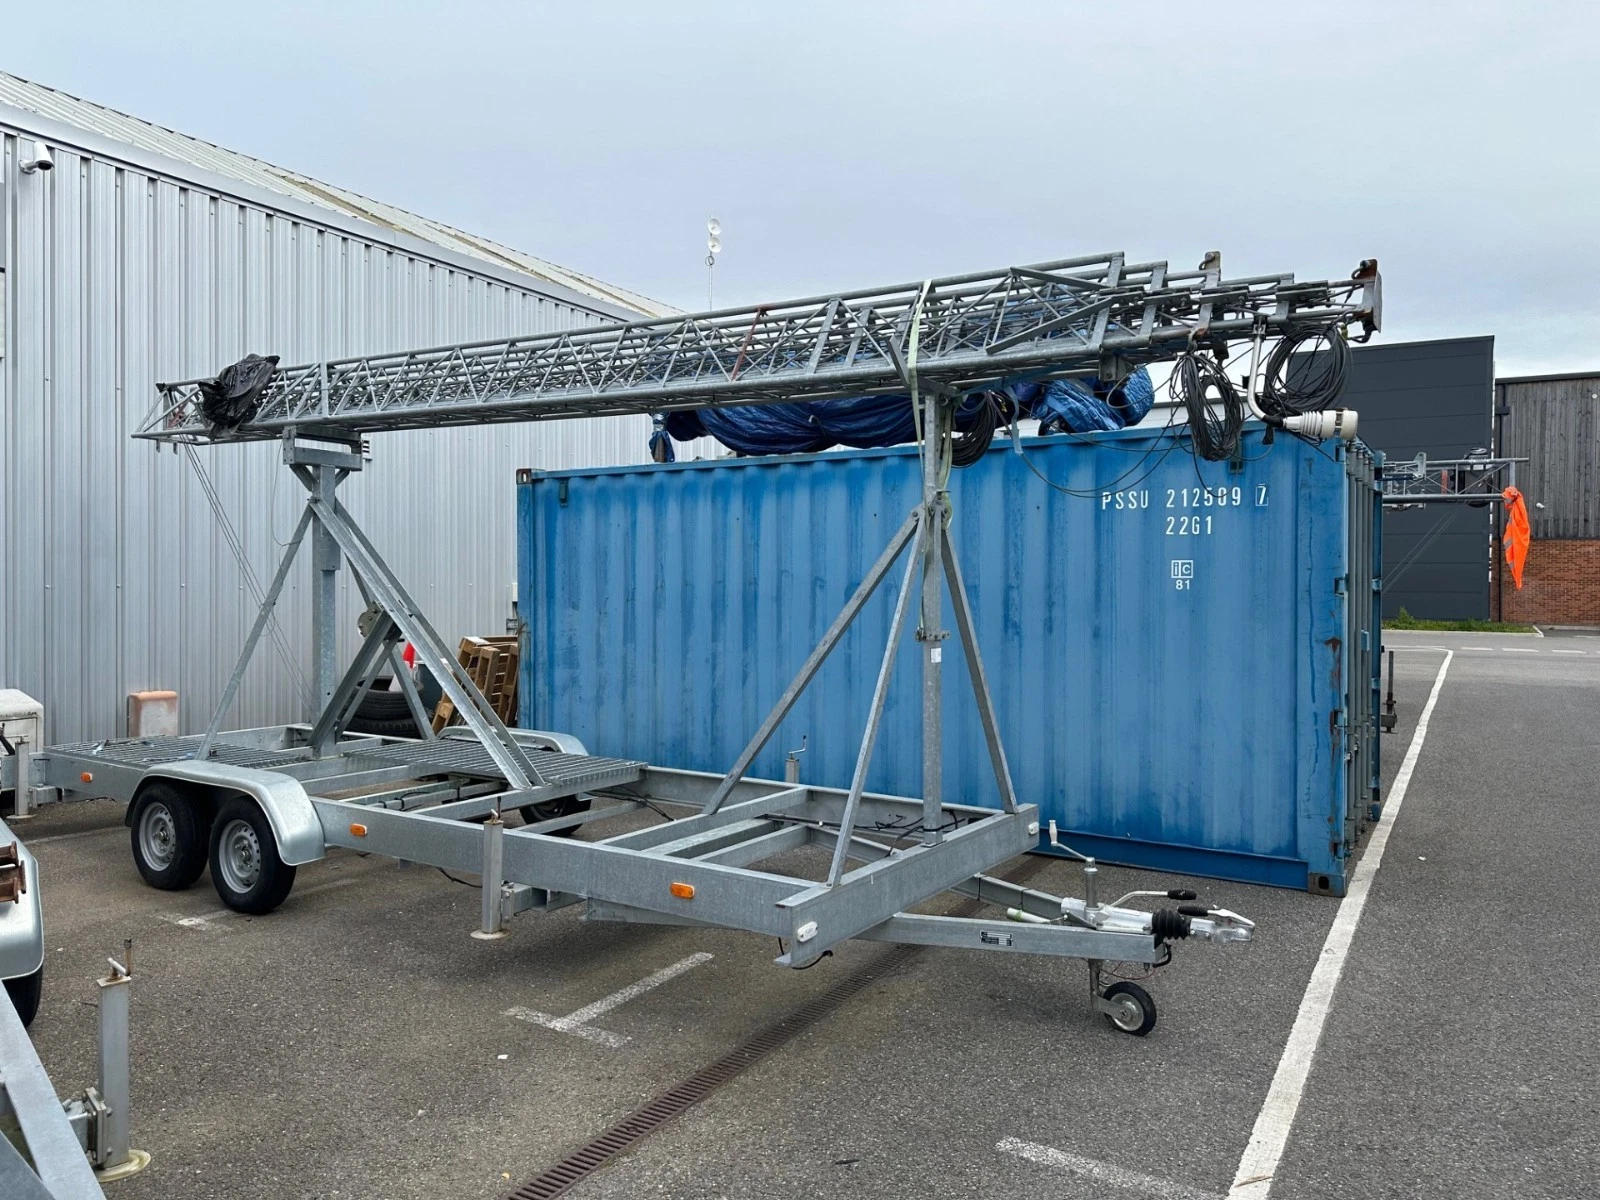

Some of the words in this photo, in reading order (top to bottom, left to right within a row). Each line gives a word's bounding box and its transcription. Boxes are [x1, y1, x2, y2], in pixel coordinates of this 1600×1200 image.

[1102, 489, 1149, 510] PSSU
[1166, 486, 1241, 508] 212509
[1256, 484, 1267, 506] 7
[1165, 516, 1212, 535] 22G1
[1175, 579, 1190, 590] 81
